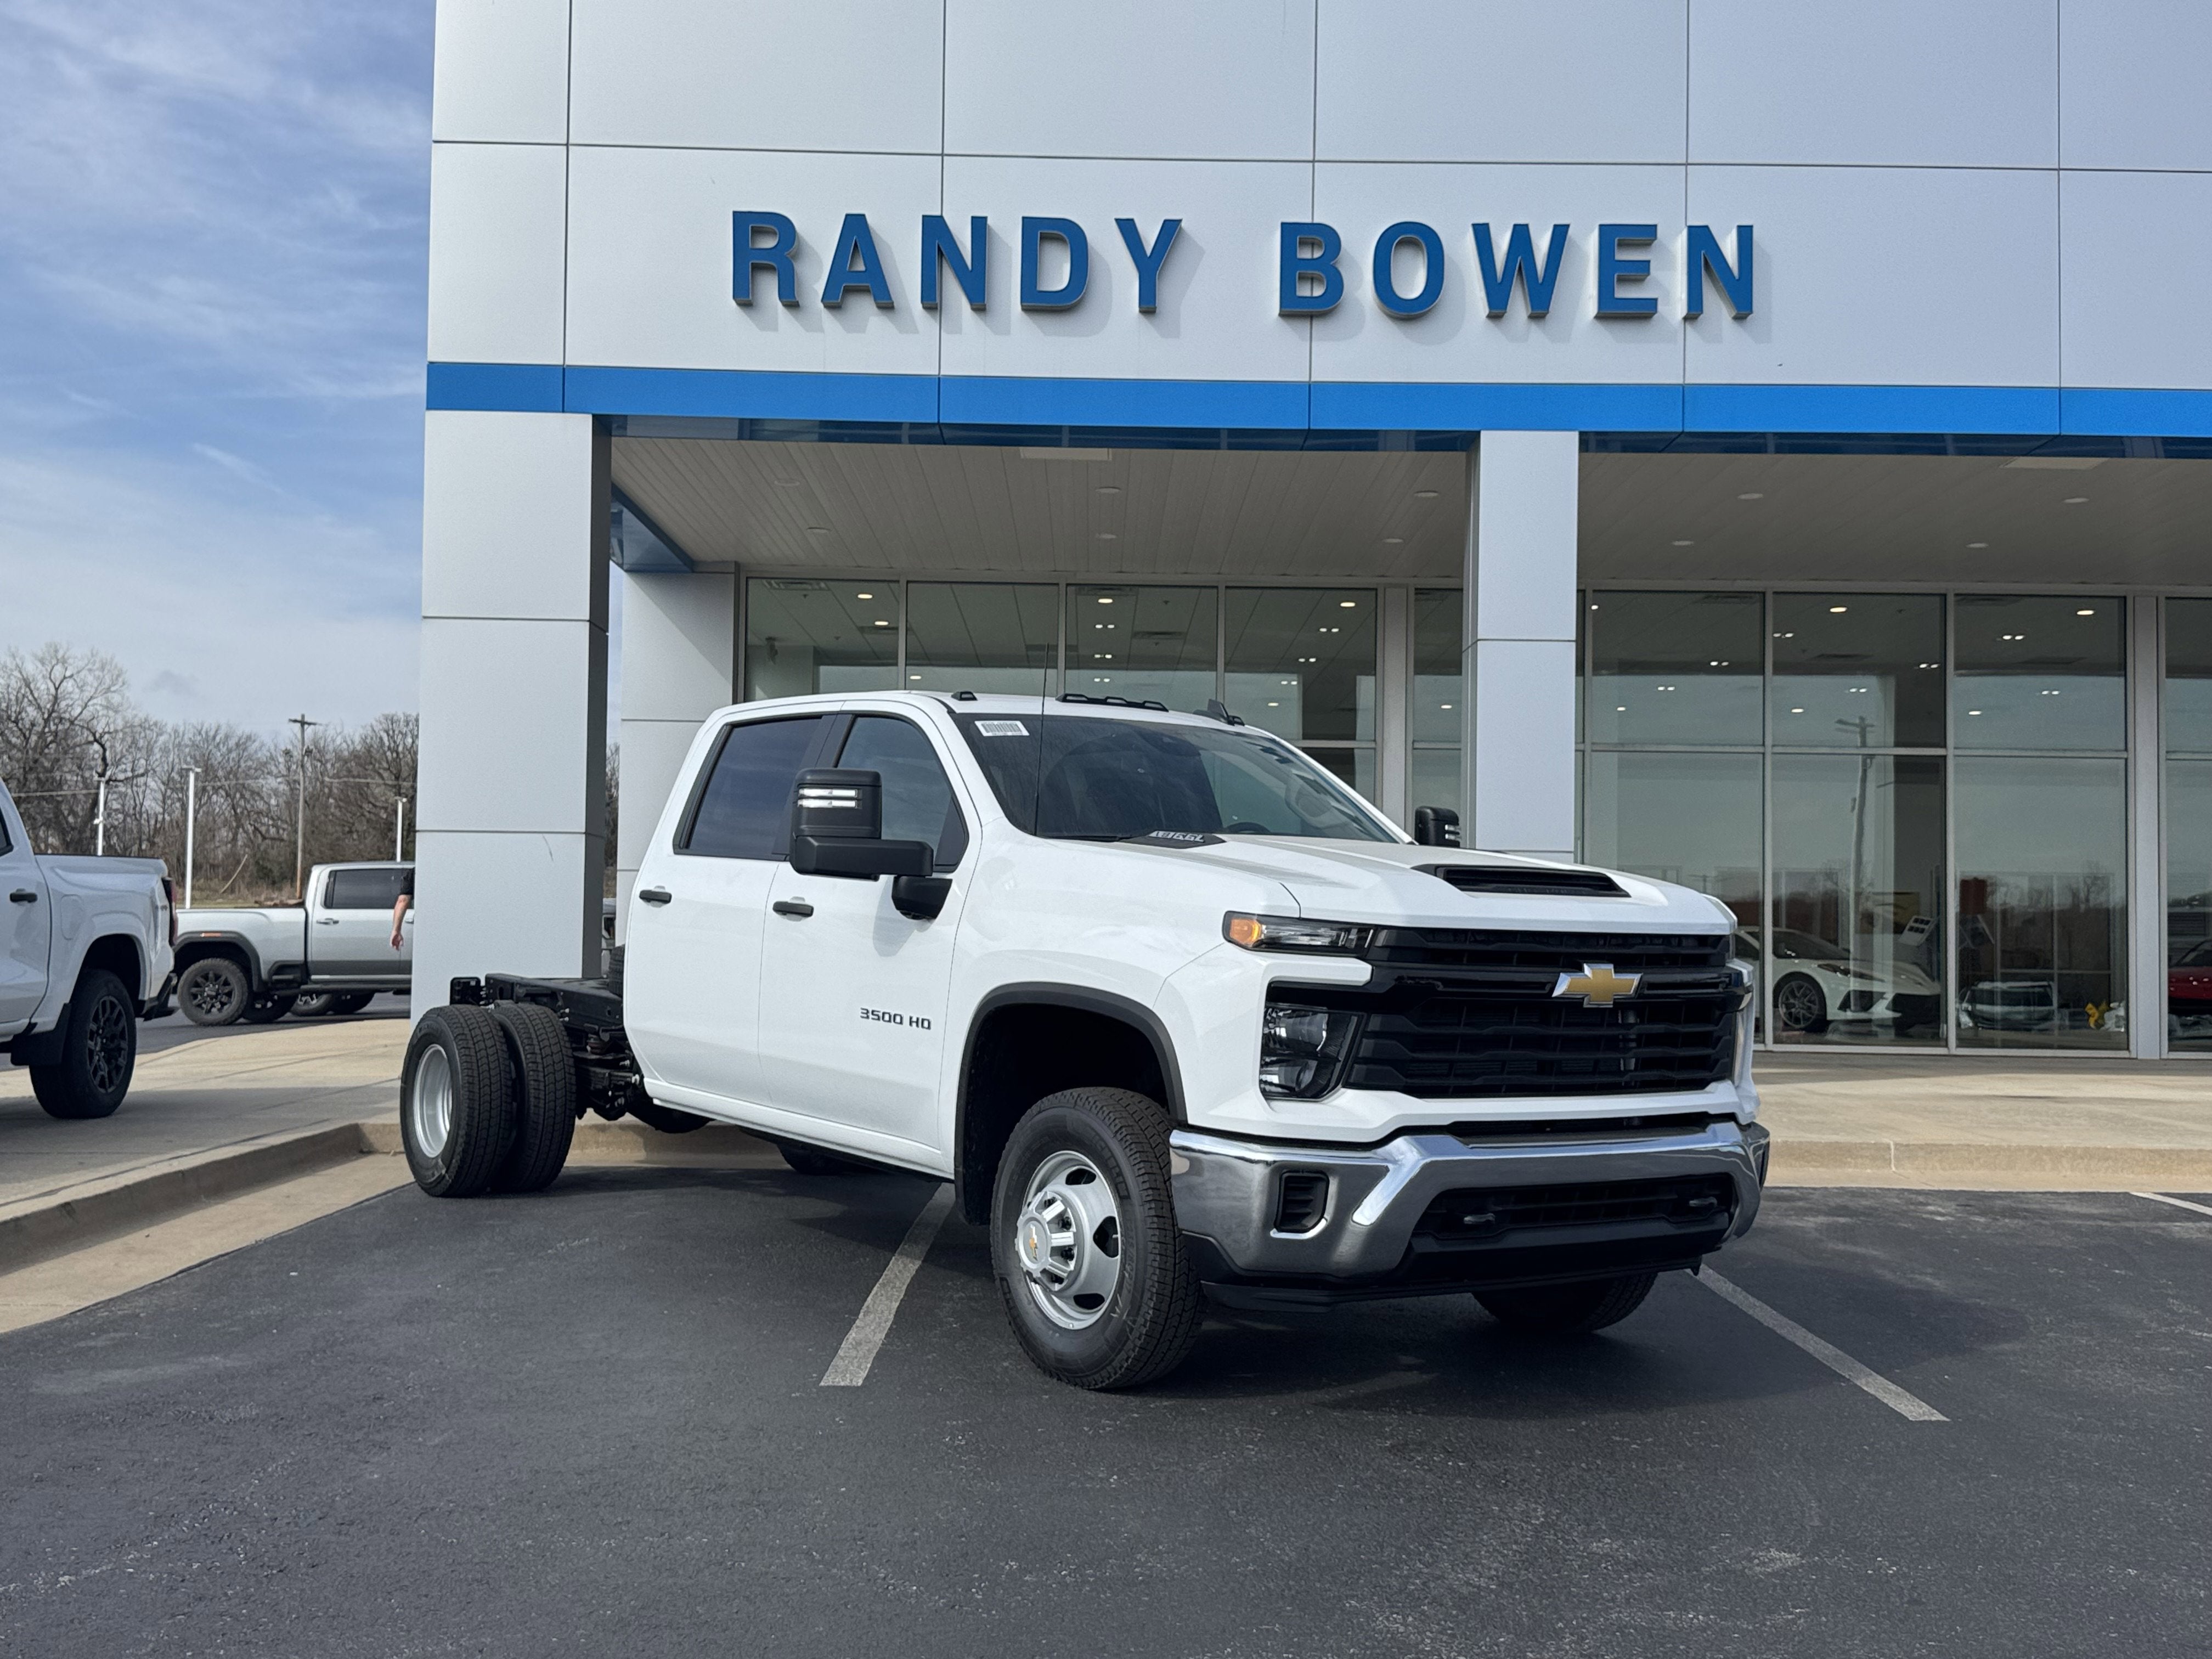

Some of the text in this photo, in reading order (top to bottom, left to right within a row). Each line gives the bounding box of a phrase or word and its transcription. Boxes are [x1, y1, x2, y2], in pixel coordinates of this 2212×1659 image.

[732, 210, 1754, 320] RANDY BOWEN
[860, 1007, 932, 1030] 3500 HD
